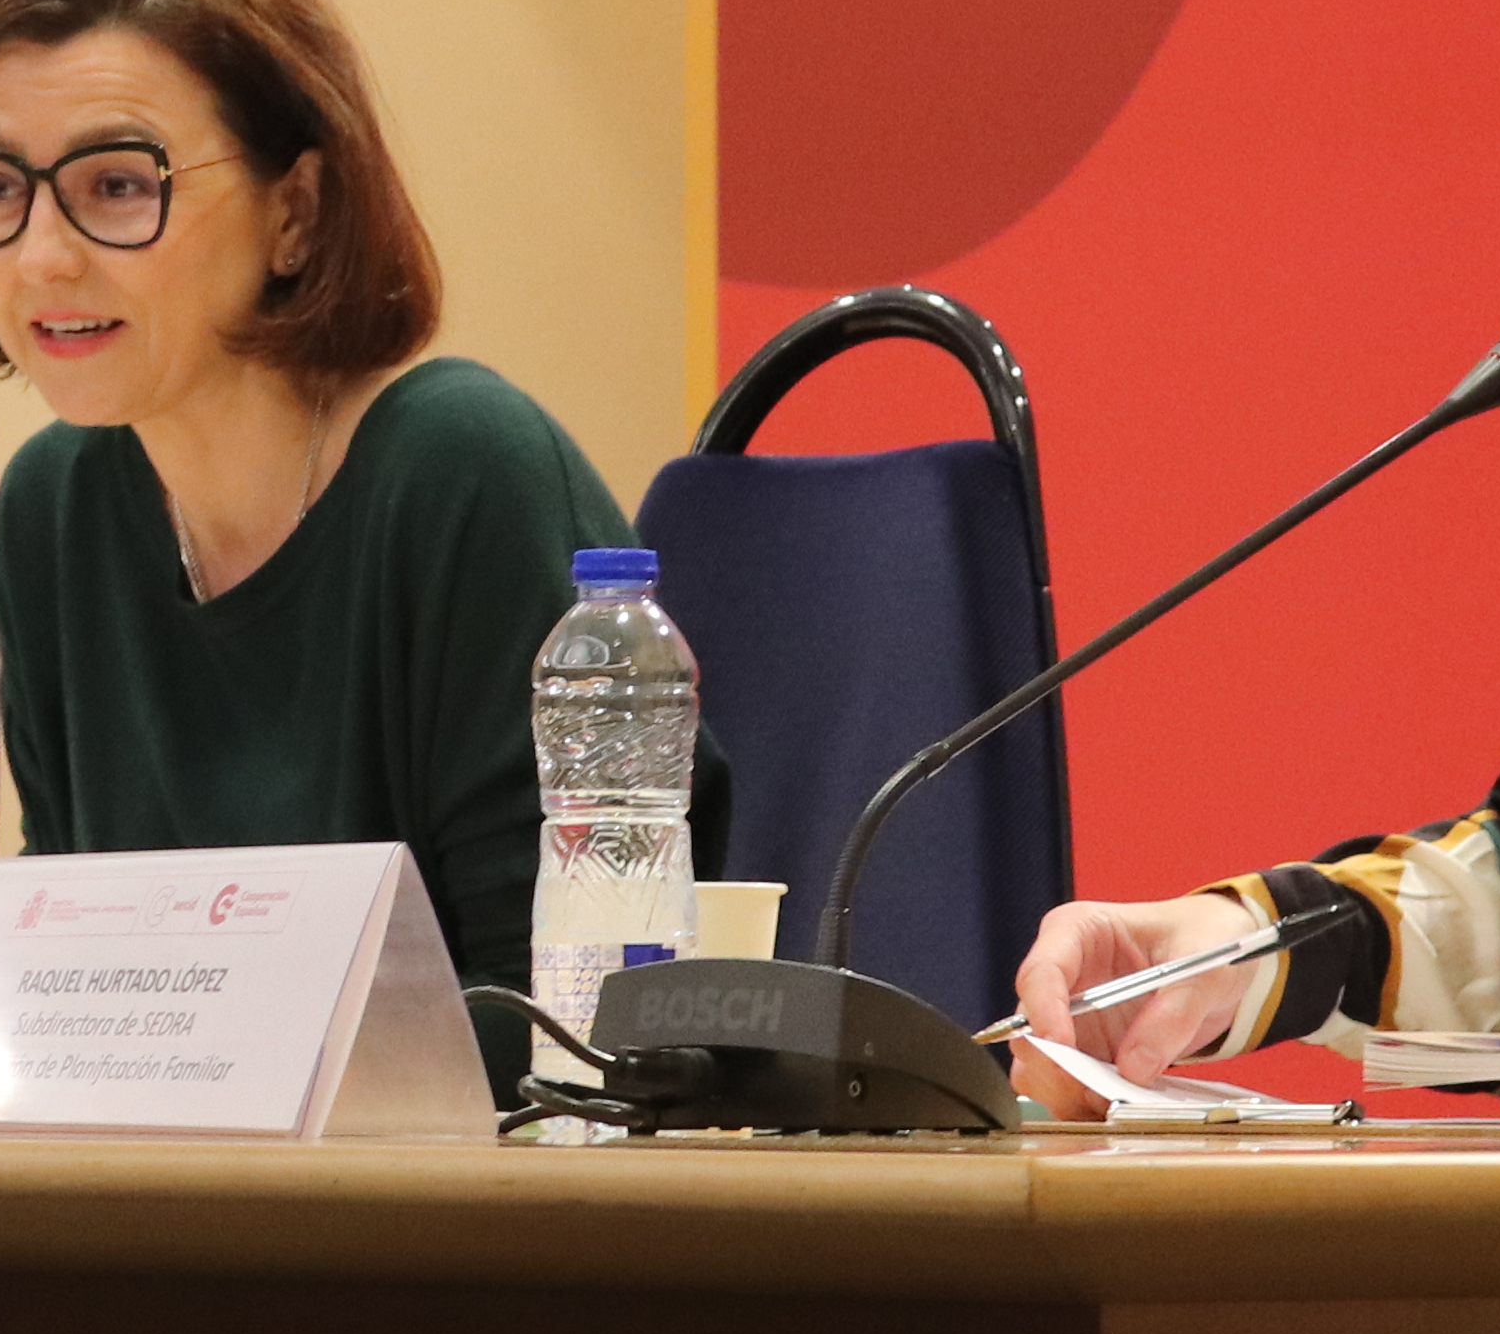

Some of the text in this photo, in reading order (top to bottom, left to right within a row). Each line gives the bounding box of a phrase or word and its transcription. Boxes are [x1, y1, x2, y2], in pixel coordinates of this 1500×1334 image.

[16, 961, 229, 997] RAQUEL HURTADO LÓPEZ
[12, 1011, 197, 1037] Subdirectora de SEDRA
[637, 987, 784, 1033] BOSCH
[34, 1054, 56, 1079] de
[57, 1054, 162, 1085] Planificación
[162, 1055, 235, 1082] Familiar
